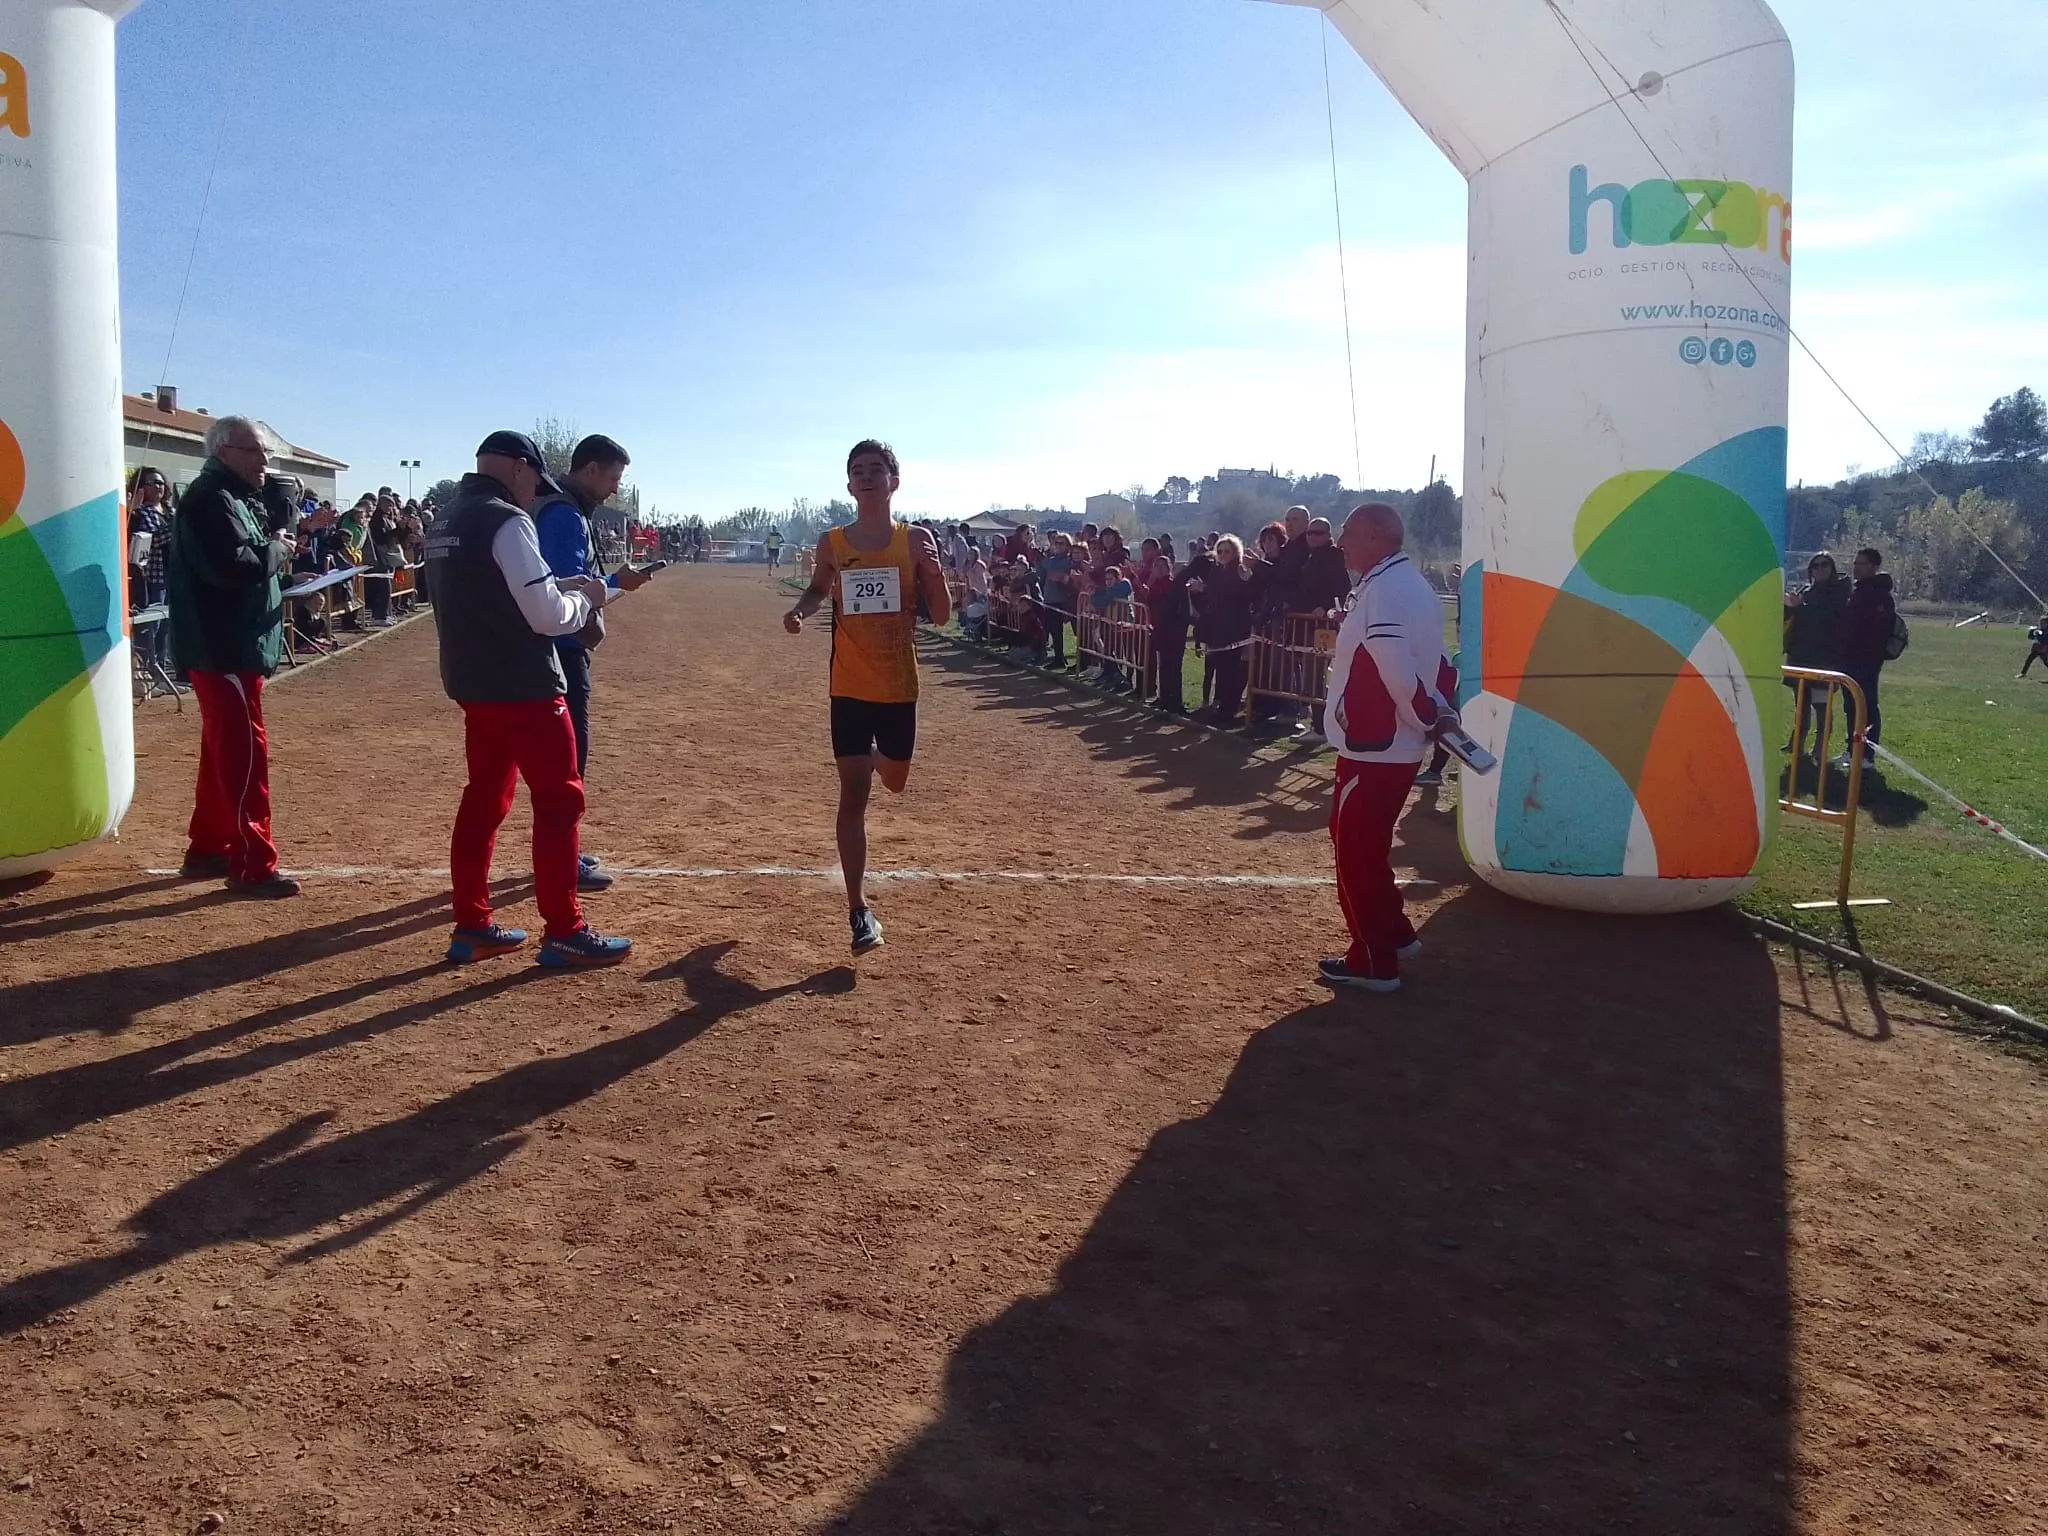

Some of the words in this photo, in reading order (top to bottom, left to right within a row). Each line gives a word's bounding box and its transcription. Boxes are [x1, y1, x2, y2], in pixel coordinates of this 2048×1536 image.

[1568, 267, 1604, 281] OCIO
[1620, 259, 1686, 274] GESTIÓN
[1620, 299, 1786, 333] www.hozona.com
[855, 582, 886, 598] 292
